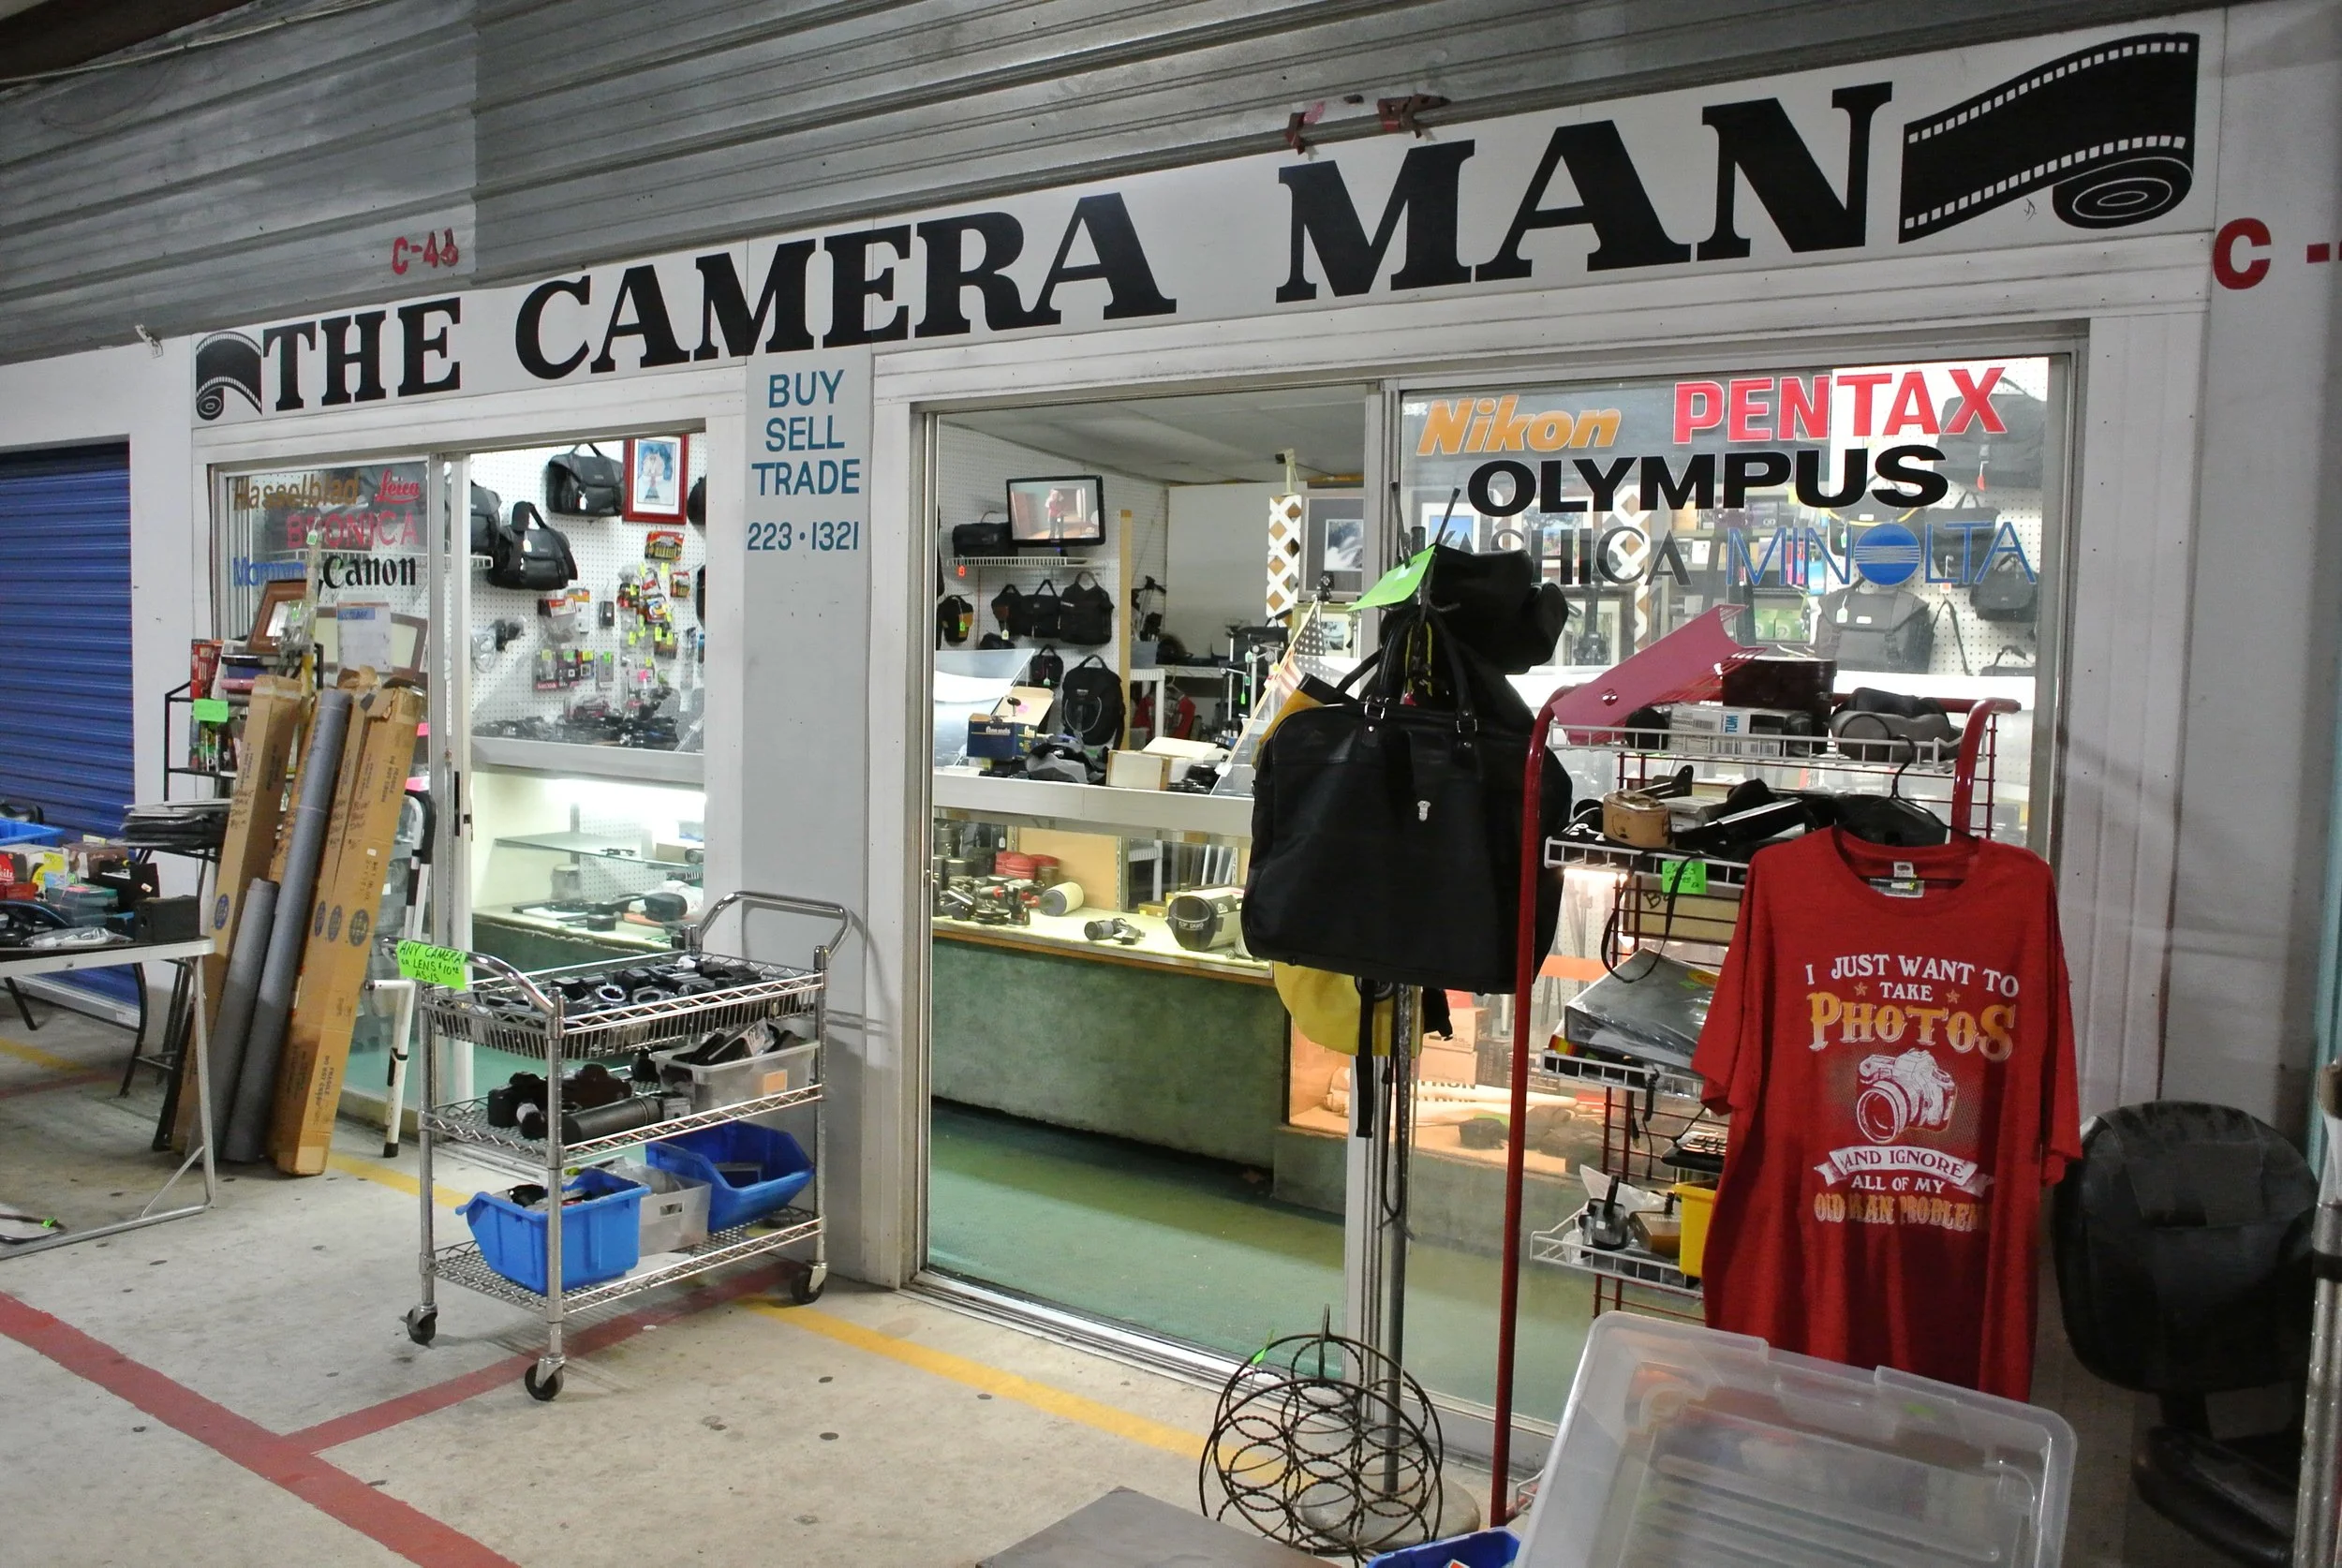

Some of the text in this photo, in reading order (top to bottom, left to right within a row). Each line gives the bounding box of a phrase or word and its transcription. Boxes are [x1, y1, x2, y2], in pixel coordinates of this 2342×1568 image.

[262, 81, 1891, 412] THE CAMERA MAN
[769, 369, 845, 408] BUY
[1416, 366, 2008, 457] Nikon PENTAX
[765, 415, 845, 451] SELL
[233, 467, 421, 511] Hasselblad Leica
[751, 458, 860, 496] TRADE
[1467, 444, 1949, 517] OLYMPUS
[322, 554, 417, 589] Canon
[1726, 521, 2038, 587] MINOLTA
[399, 941, 464, 965] ANY CAMERA
[413, 958, 437, 972] LENS
[1806, 954, 2020, 998] I JUST WANT TO
[1879, 981, 1934, 1003] TAKE
[1806, 991, 2017, 1062] PHOTOS
[1842, 1149, 1966, 1180] AND IGNORE
[1850, 1176, 1947, 1194] ALL OF MY
[1814, 1193, 1846, 1224] OLD
